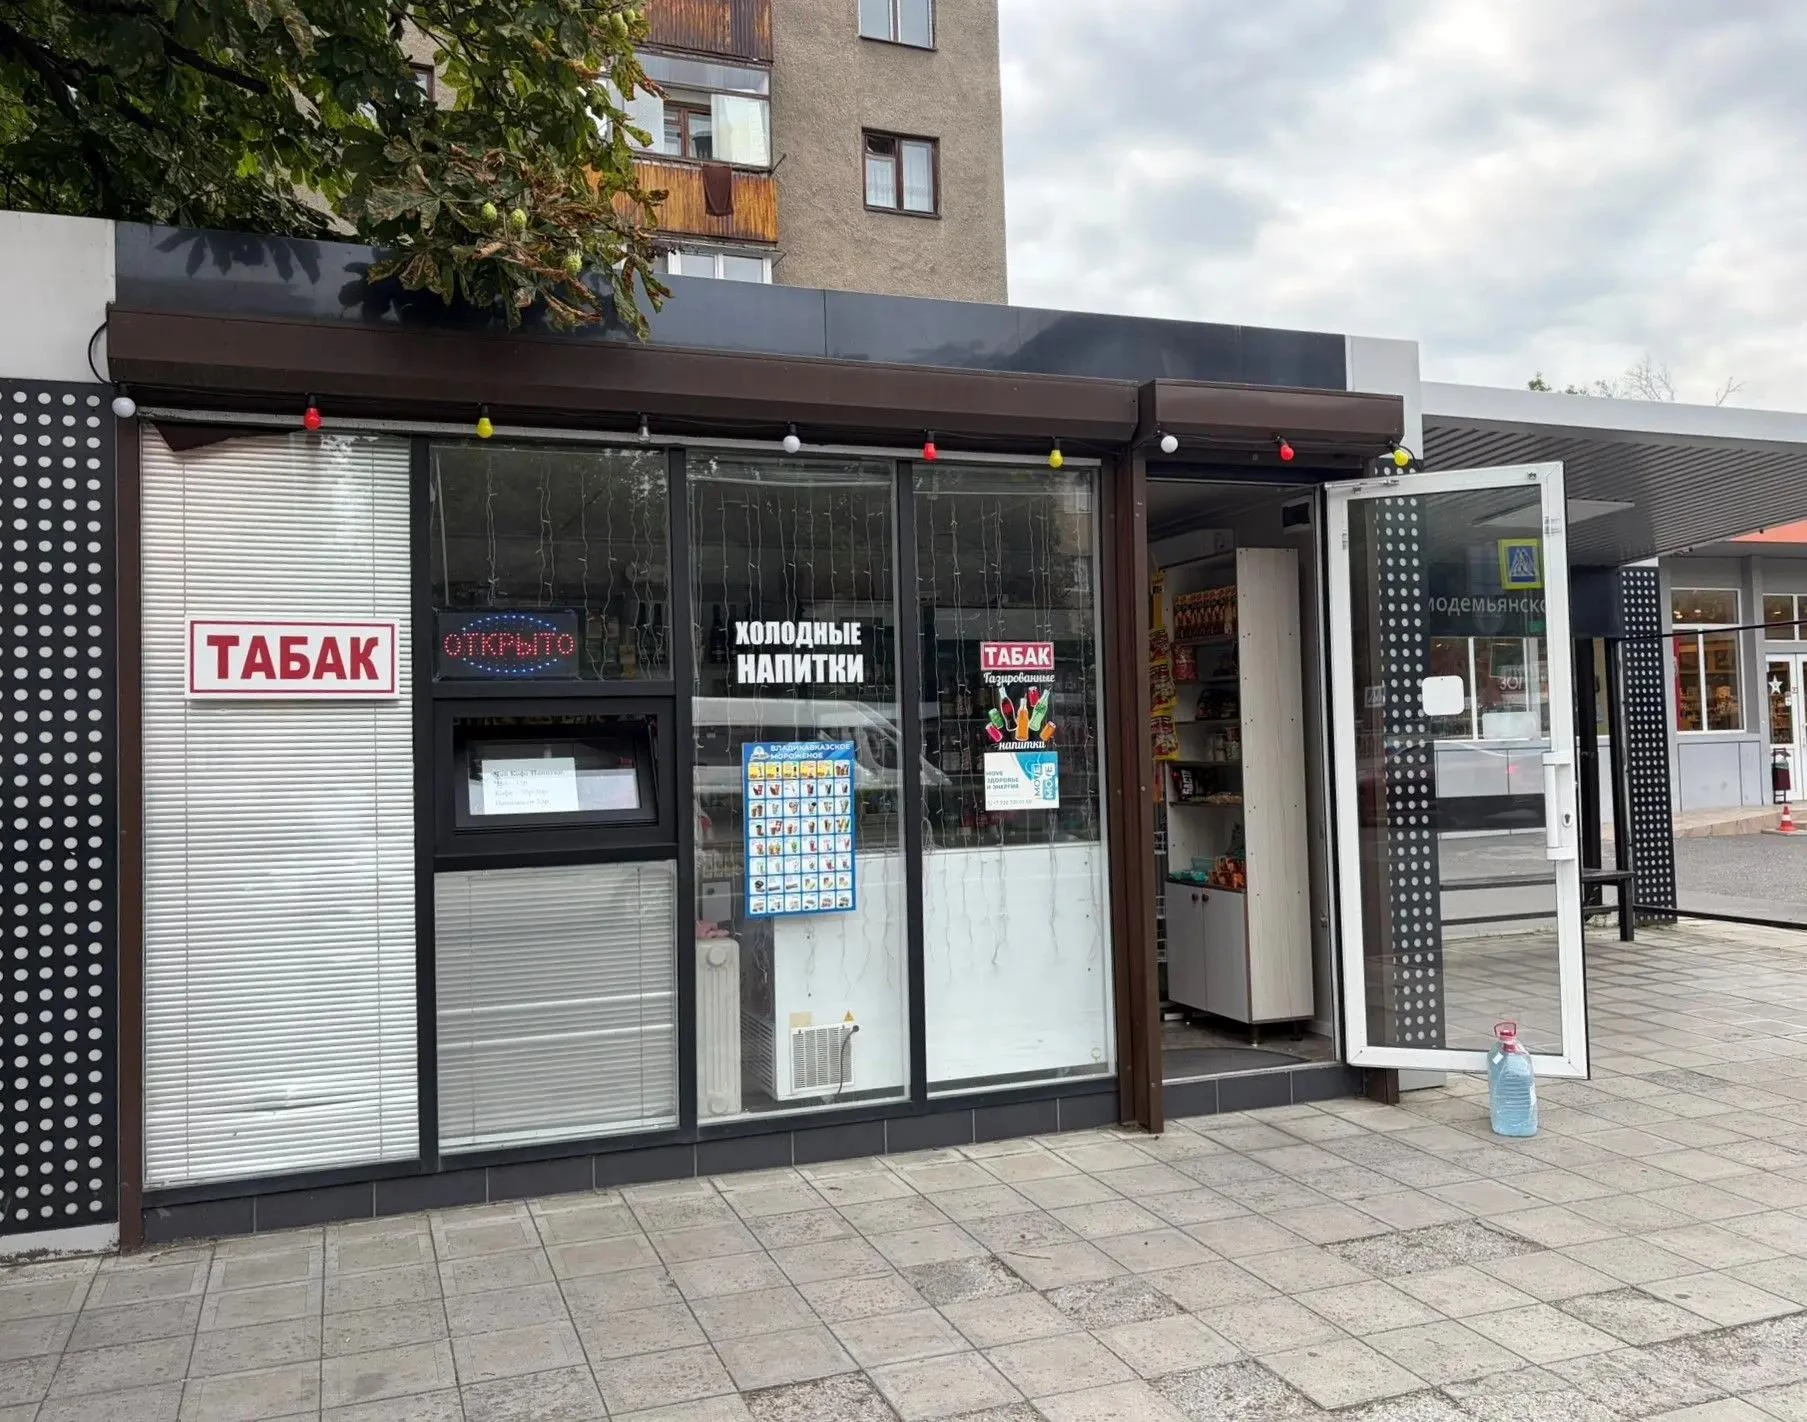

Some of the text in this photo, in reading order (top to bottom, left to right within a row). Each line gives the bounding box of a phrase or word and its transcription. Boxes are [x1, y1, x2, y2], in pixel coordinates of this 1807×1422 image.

[443, 632, 575, 657] ОТКРЫТО
[735, 621, 862, 648] ХОЛОДНЫЕ
[206, 634, 380, 680] ТАБАК
[984, 646, 1050, 666] ТАБАК
[737, 654, 864, 684] НАПИТКИ
[983, 672, 1055, 686] Газированные
[770, 743, 851, 752] ВЛАДИКАВКАЗСКОЕ
[999, 741, 1046, 750] напитки
[770, 752, 824, 760] МОРОЖЕНОЕ
